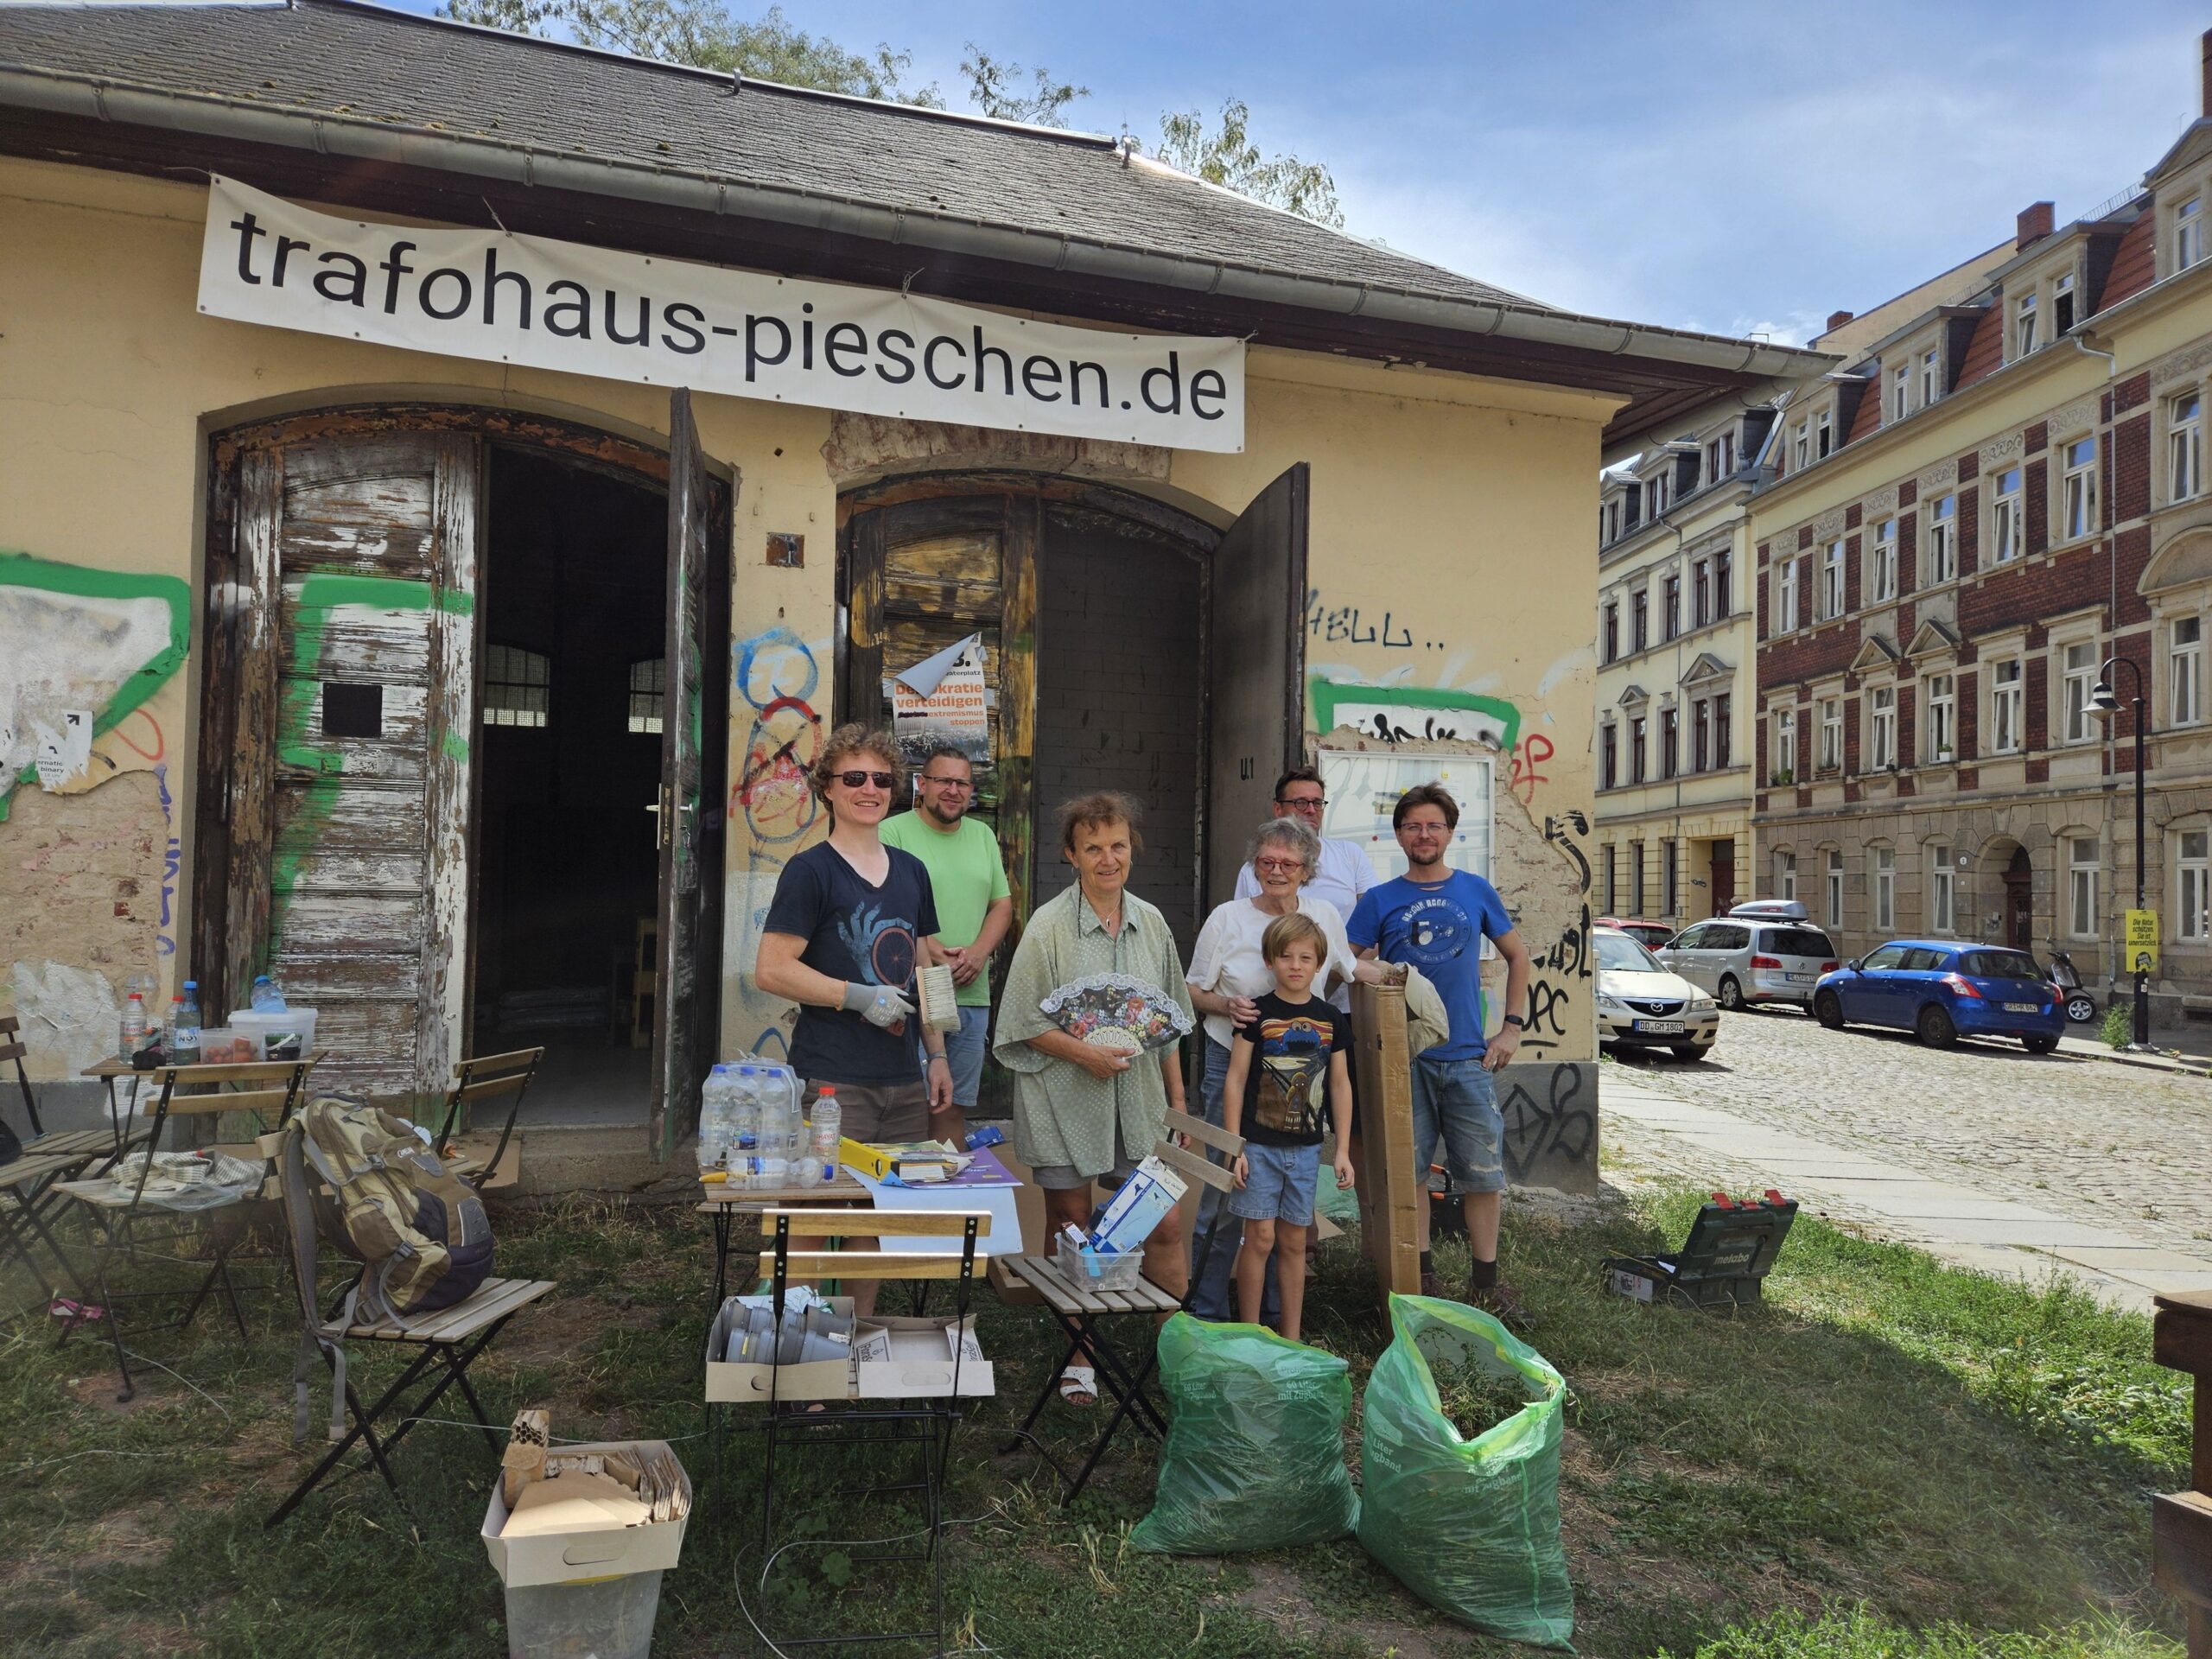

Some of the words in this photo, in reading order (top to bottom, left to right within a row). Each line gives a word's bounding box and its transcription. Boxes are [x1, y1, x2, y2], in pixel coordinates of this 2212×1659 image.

[230, 212, 1228, 421] trafohaus-pieschen.de
[895, 683, 982, 695] Dekratie
[896, 696, 983, 709] verteidigen
[950, 718, 985, 727] stoppen
[1640, 1021, 1649, 1031] DD
[1655, 1022, 1664, 1031] GM
[1665, 1023, 1683, 1032] 1802
[1713, 1254, 1750, 1266] metabo
[1373, 1437, 1395, 1456] Liter
